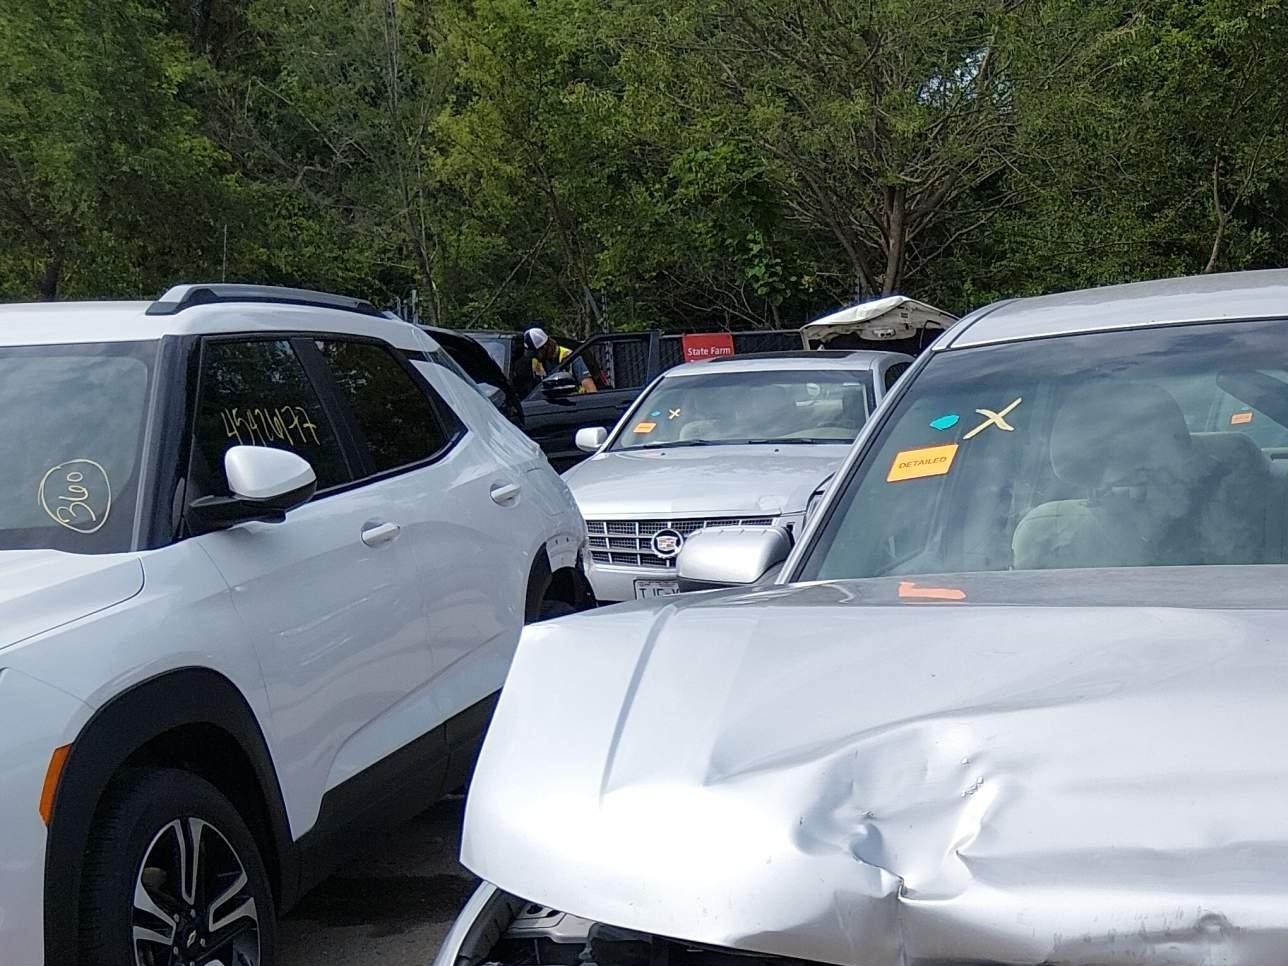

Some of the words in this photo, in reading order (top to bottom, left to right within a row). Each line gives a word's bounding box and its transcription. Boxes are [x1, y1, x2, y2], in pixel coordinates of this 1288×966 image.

[687, 347, 709, 356] State
[710, 346, 731, 355] Farm
[898, 456, 948, 469] DETAILED
[57, 472, 97, 523] 360
